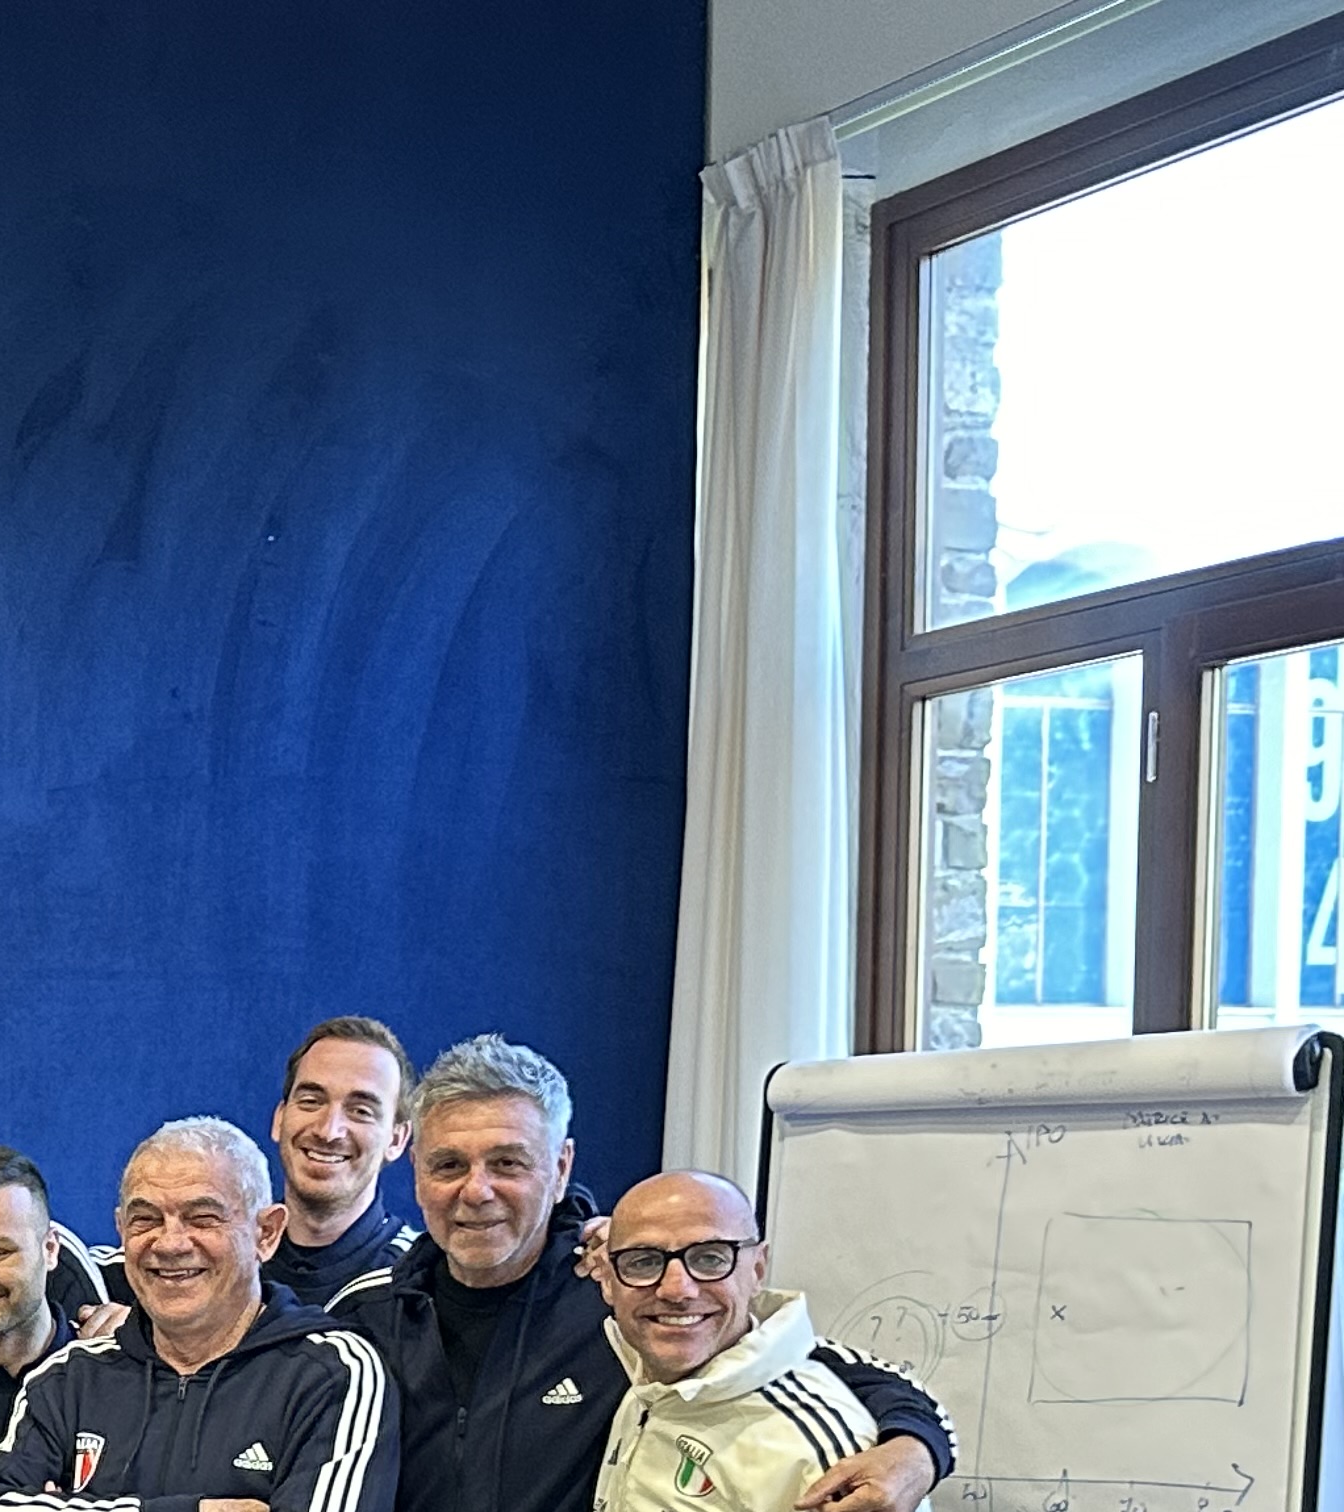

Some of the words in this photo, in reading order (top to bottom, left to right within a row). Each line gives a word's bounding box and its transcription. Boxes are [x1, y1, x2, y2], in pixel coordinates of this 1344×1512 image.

[542, 1393, 583, 1405] adidas
[677, 1438, 706, 1463] ITALIA
[232, 1458, 273, 1471] adidas
